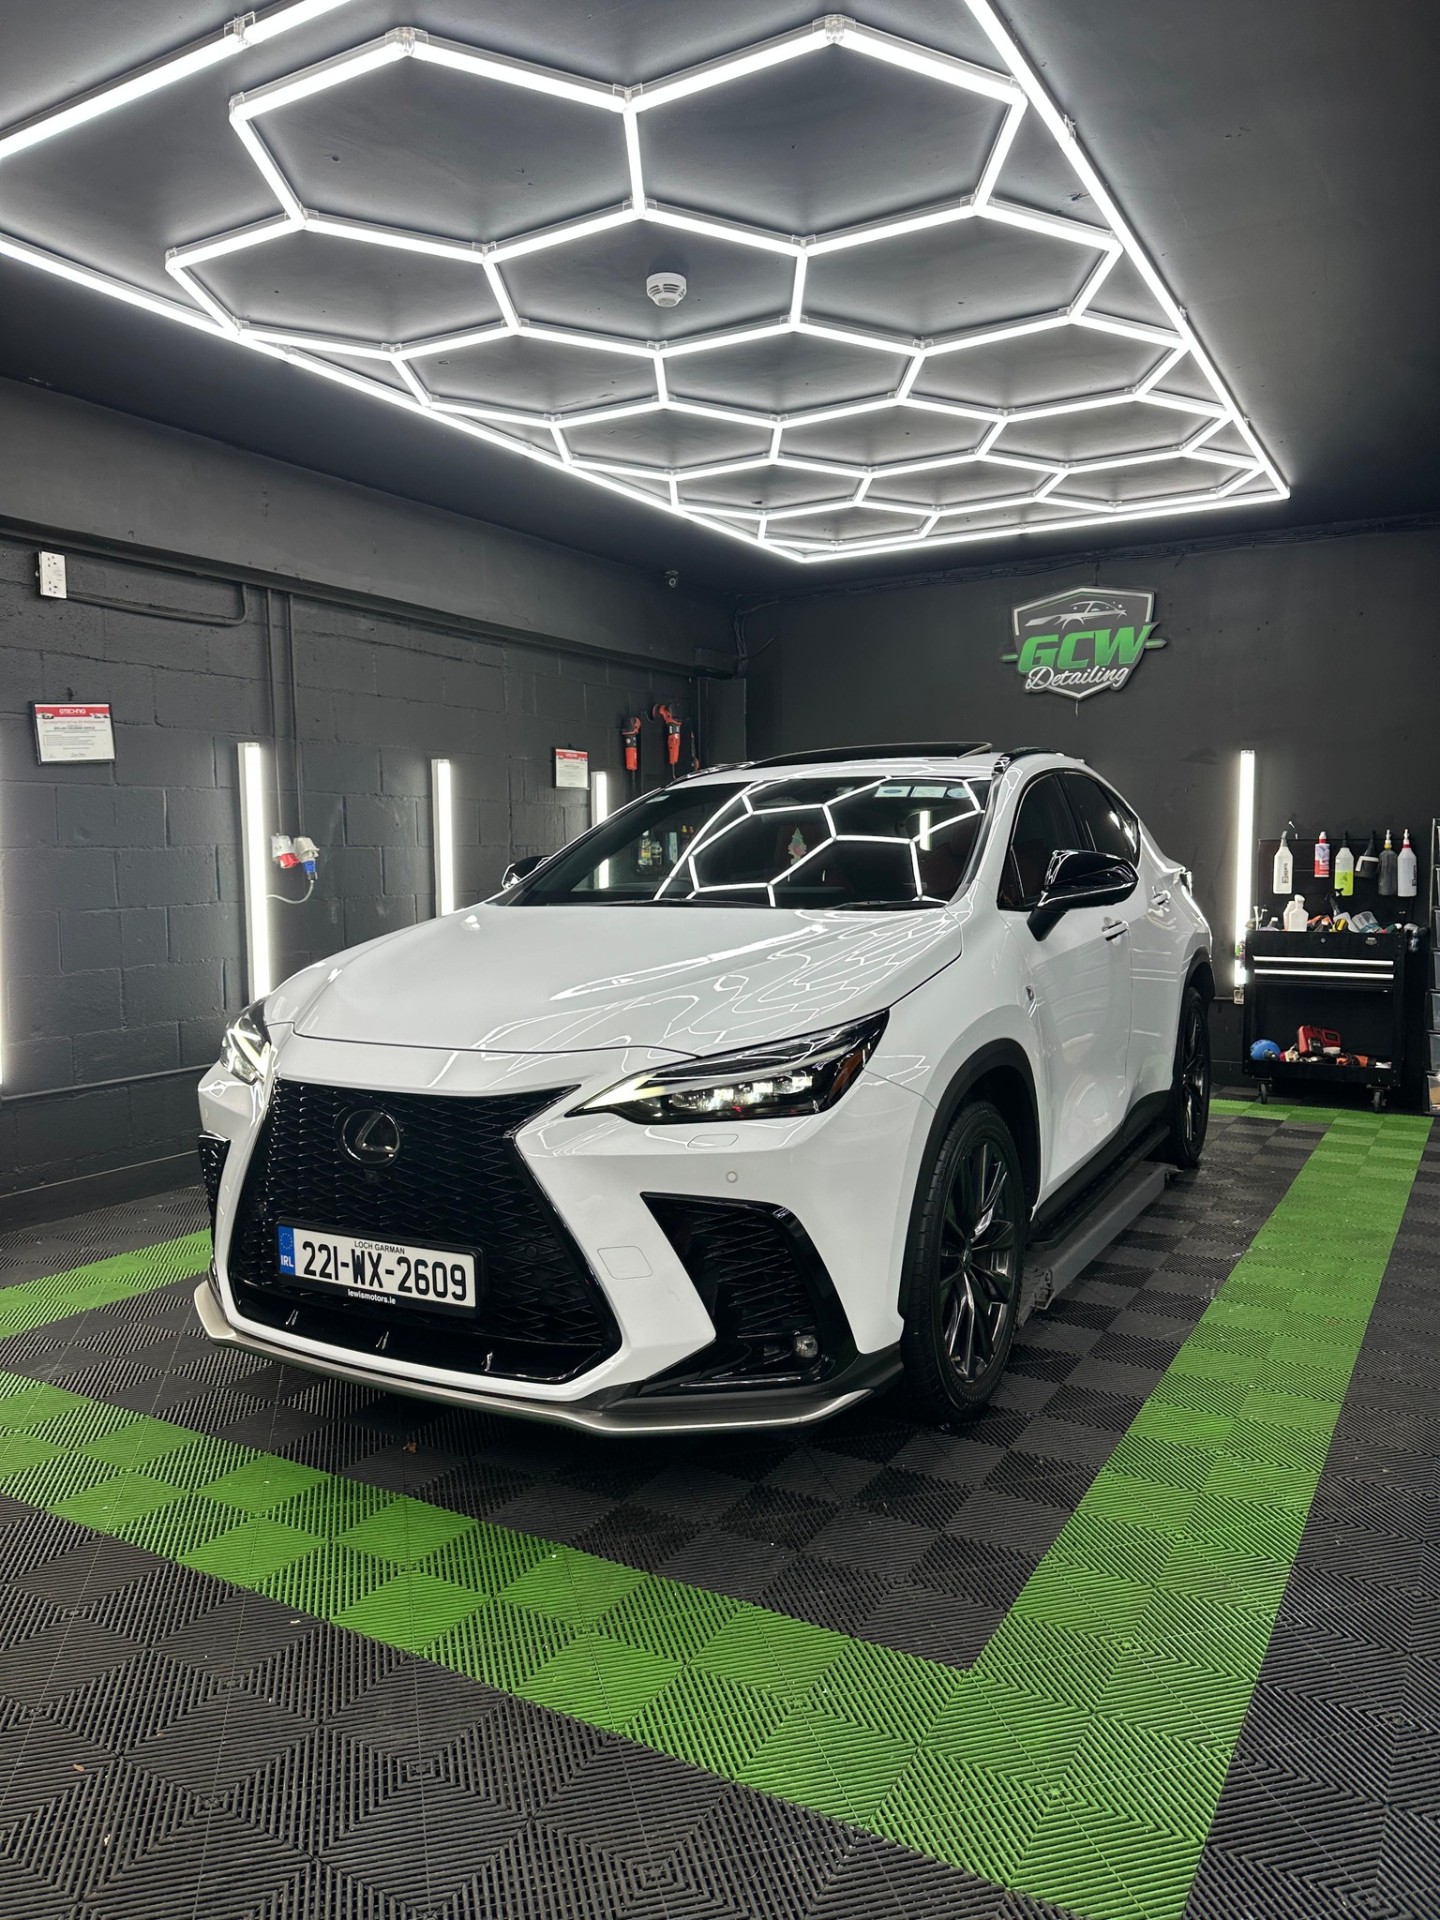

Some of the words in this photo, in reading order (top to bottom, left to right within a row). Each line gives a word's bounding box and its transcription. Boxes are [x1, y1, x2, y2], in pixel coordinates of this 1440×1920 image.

[1018, 624, 1153, 673] GCW
[1025, 665, 1129, 690] Detailing
[353, 1240, 373, 1250] LOCH
[374, 1243, 405, 1255] GARMAN
[280, 1254, 294, 1268] IRL
[302, 1240, 467, 1302] 221-WX-2609
[347, 1288, 396, 1305] lewismotors.ie
